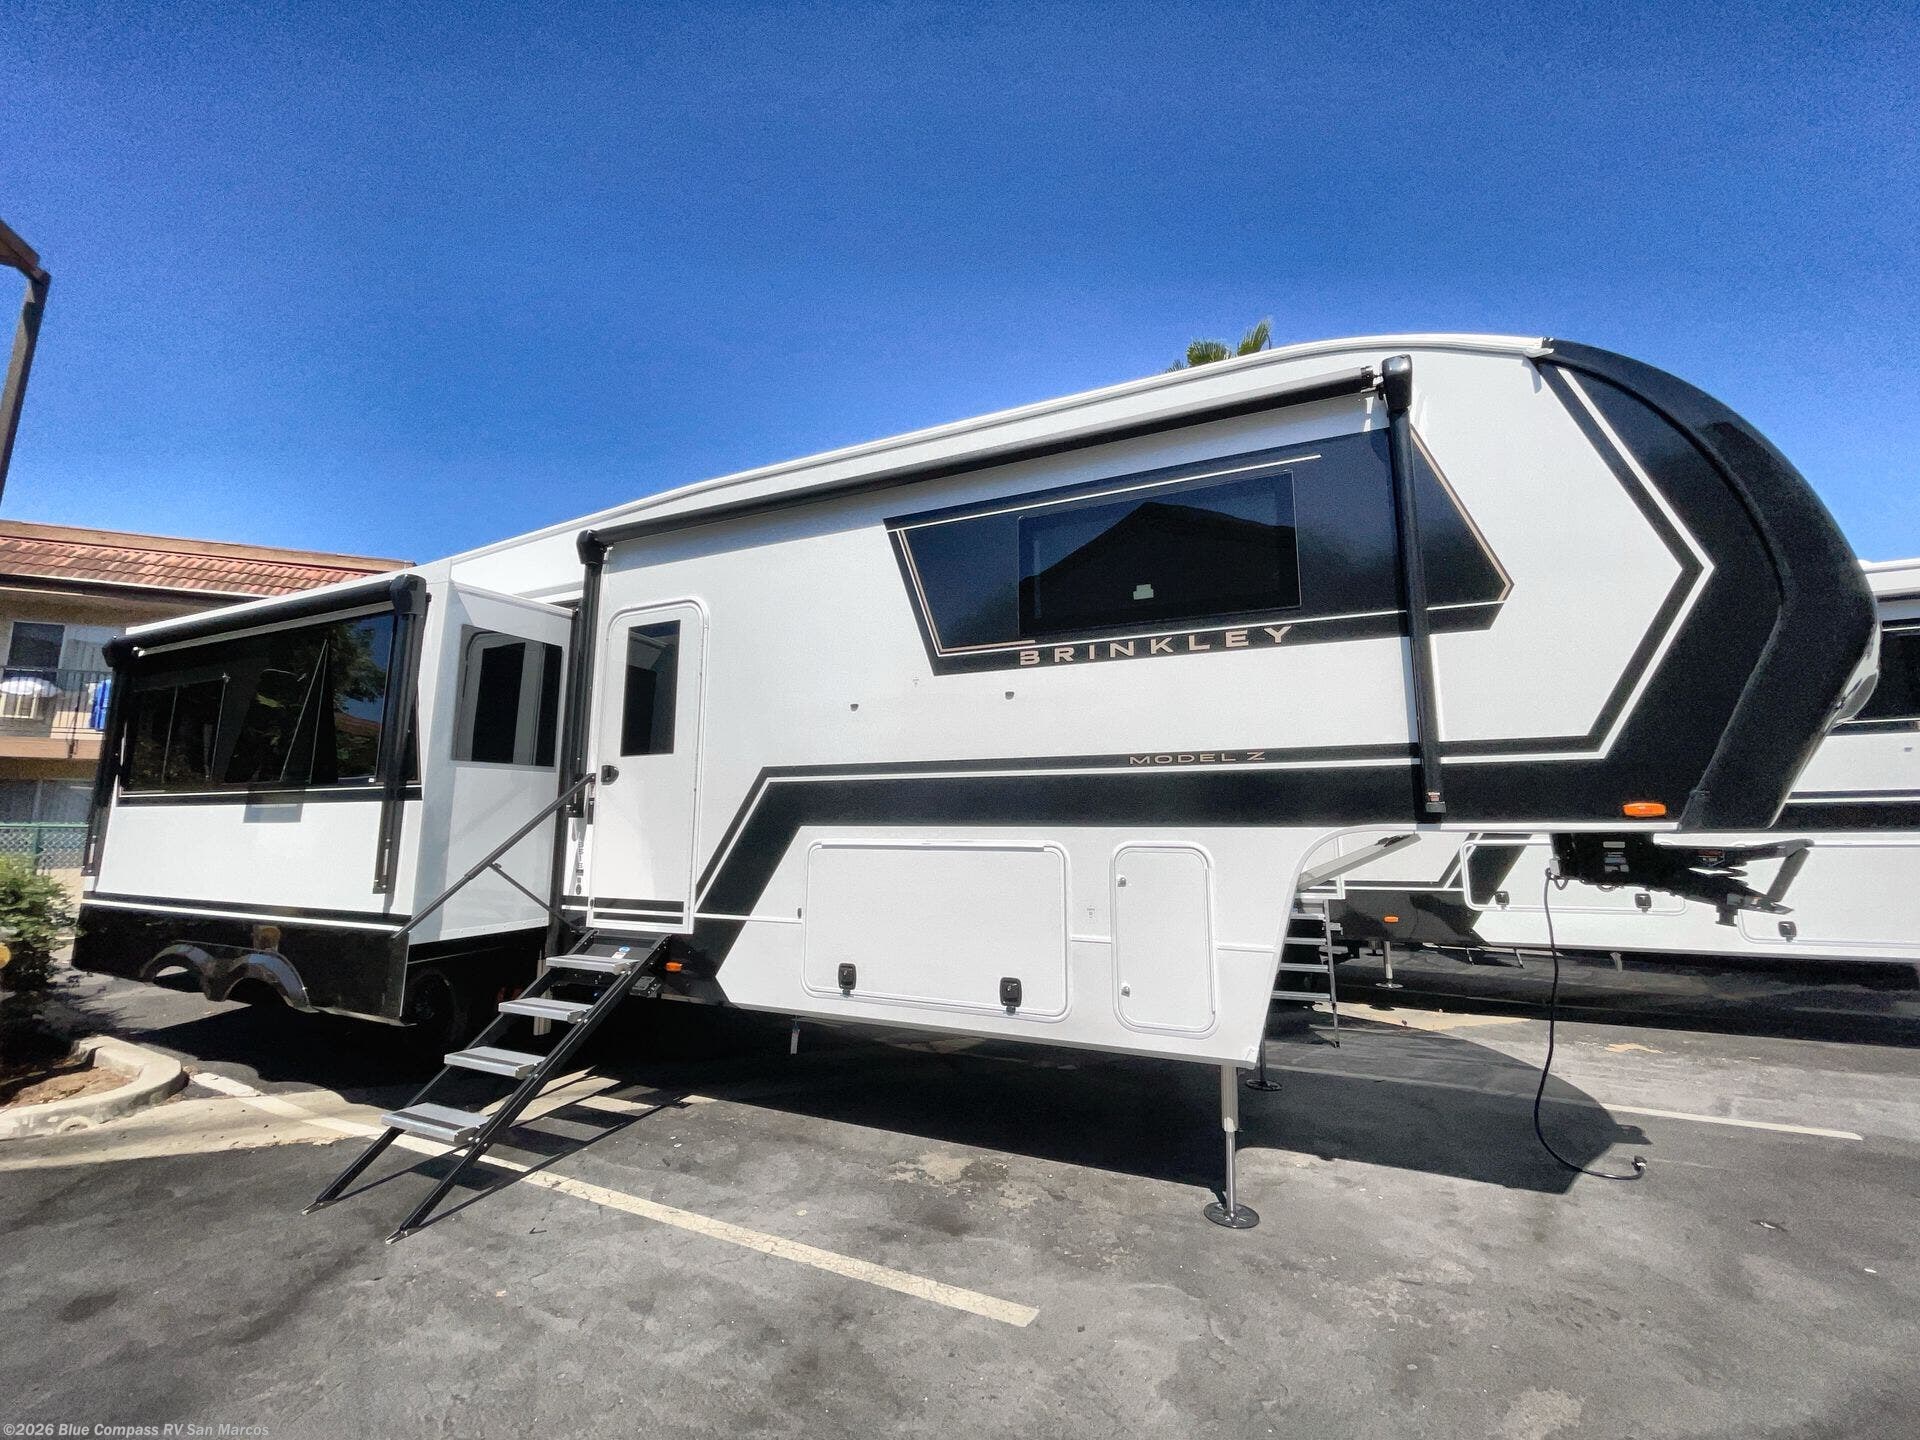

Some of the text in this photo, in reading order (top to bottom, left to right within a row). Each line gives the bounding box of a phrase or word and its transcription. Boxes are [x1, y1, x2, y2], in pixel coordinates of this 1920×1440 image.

[1019, 624, 1293, 666] BRINKLEY
[1129, 751, 1266, 765] MODEL Z
